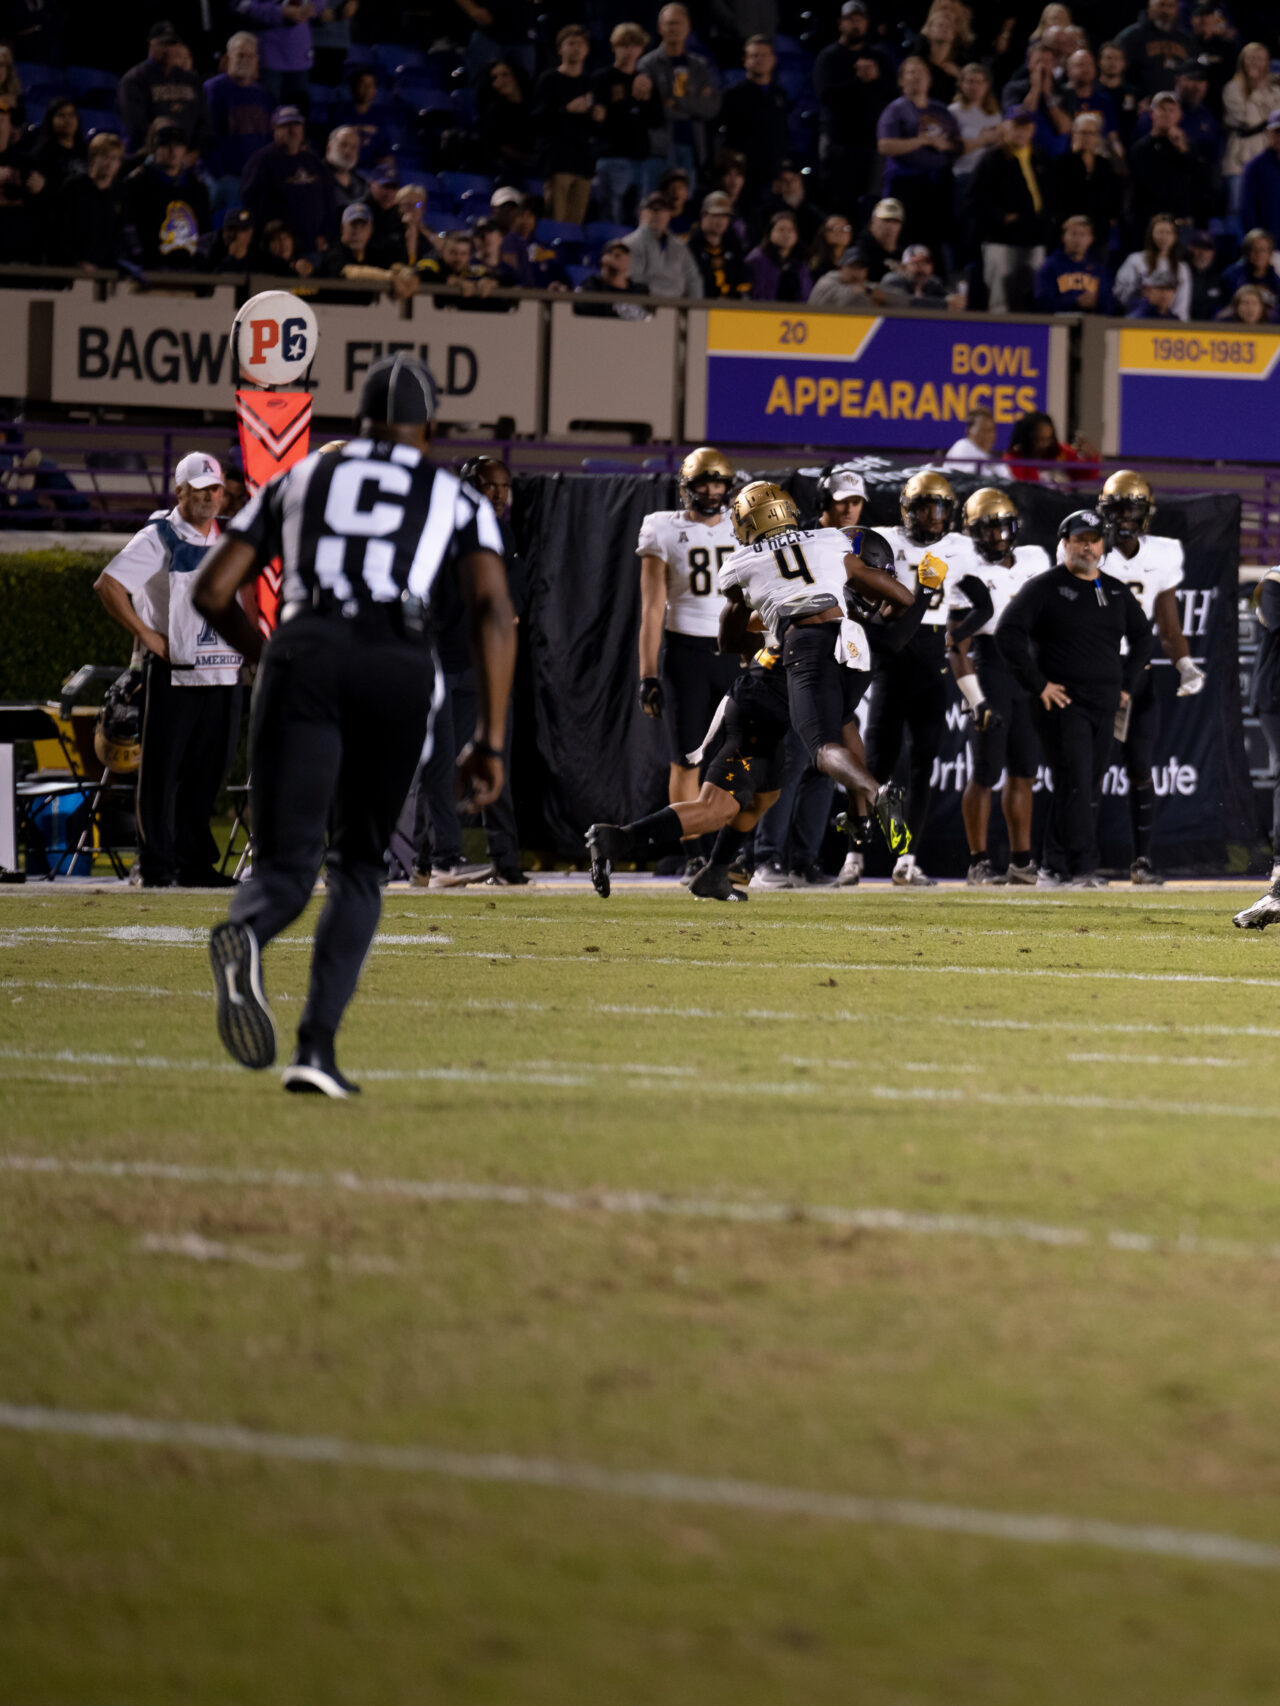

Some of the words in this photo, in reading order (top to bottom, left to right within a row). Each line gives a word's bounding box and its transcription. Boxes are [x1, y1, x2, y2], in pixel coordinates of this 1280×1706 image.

[249, 317, 307, 364] P6
[779, 321, 807, 344] 20
[1151, 338, 1255, 365] 1980-1983
[78, 326, 318, 386] BAGW
[951, 343, 1038, 378] BOWL
[765, 375, 1038, 424] APPEARANCES
[324, 459, 413, 537] C
[773, 543, 816, 585] 4
